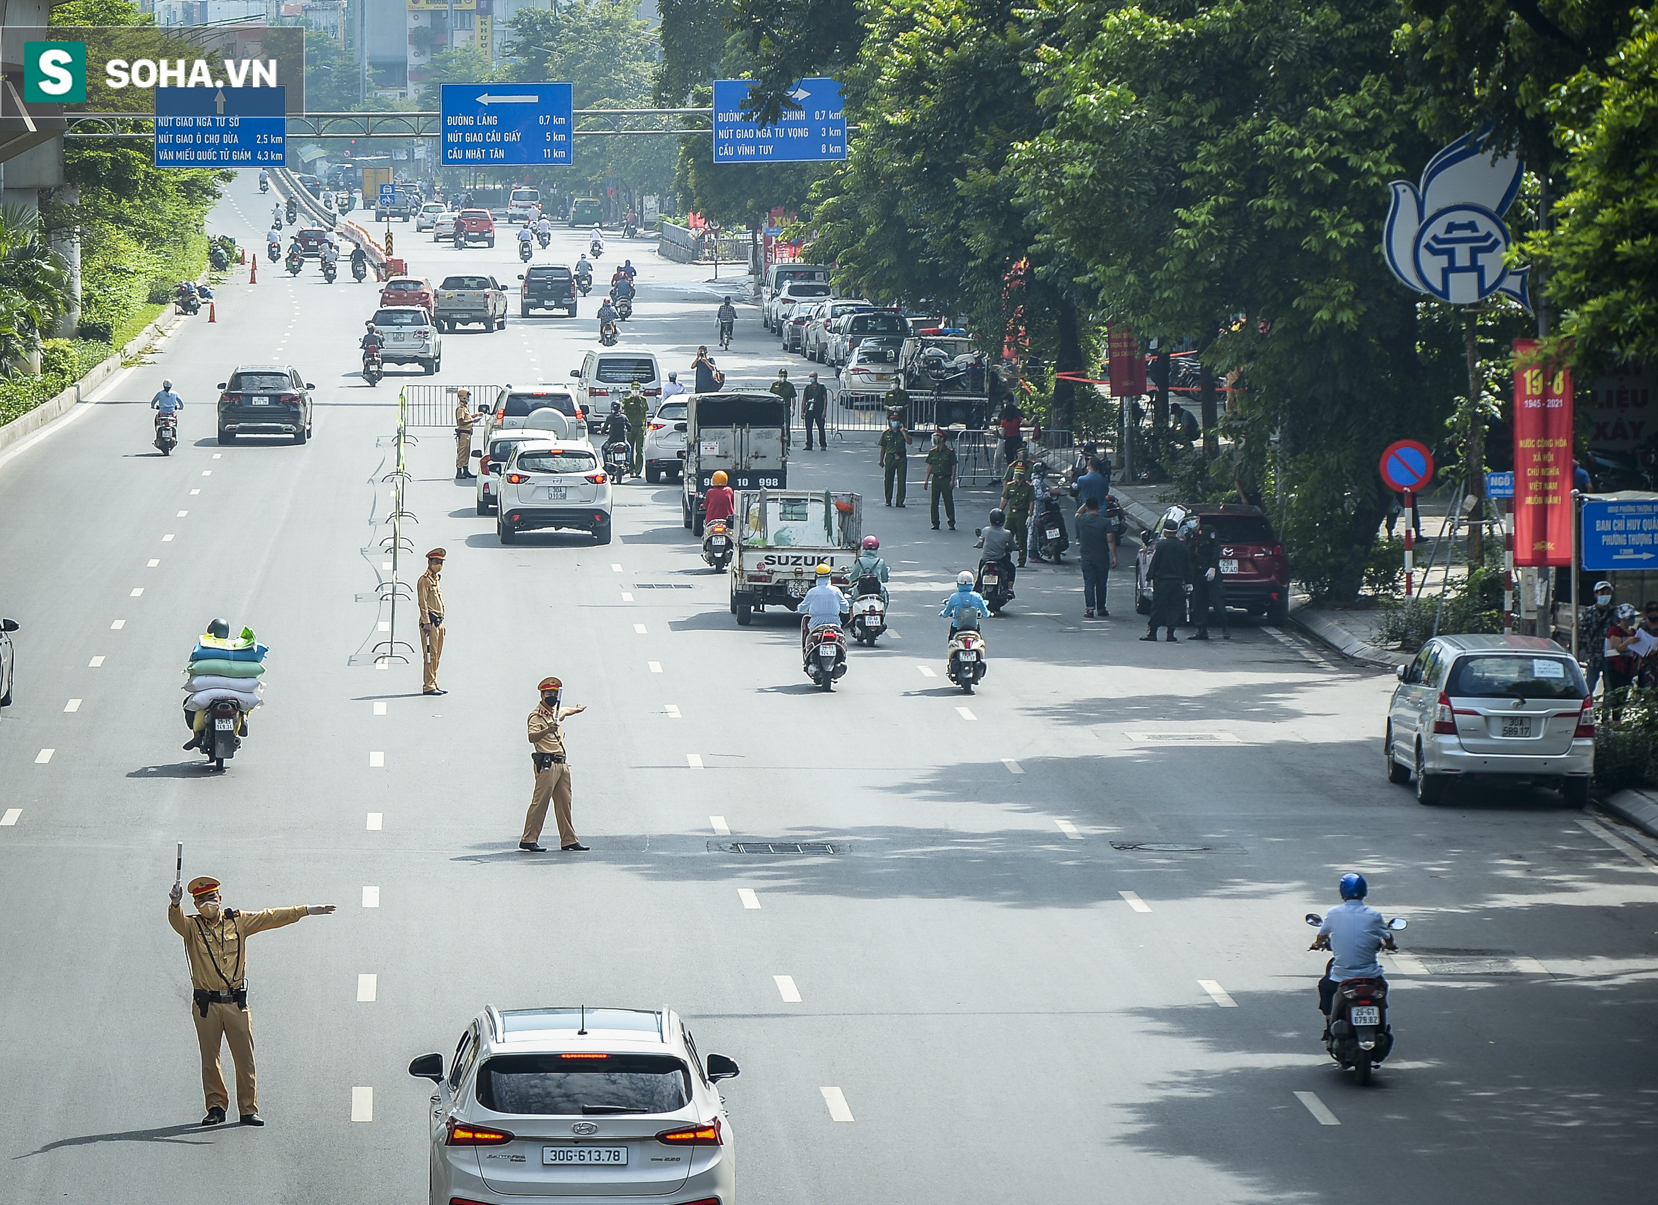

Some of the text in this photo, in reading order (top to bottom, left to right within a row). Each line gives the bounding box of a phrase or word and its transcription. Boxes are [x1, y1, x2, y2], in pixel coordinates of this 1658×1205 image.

[158, 115, 173, 127] NÚT
[175, 118, 194, 127] GIAO
[447, 113, 474, 126] ĐƯỜNG
[477, 113, 498, 126] LÁNG
[553, 115, 566, 125] km
[829, 110, 842, 120] km
[158, 132, 173, 144] NÚT
[175, 134, 194, 144] GIAO
[196, 132, 202, 144] Ô
[204, 134, 220, 146] CHỢ
[271, 134, 283, 144] km
[447, 129, 566, 142] NÚT GIAO CẦU GIẤY 5 km
[718, 127, 842, 139] NÚT GIAO NGÃ TƯ VỌNG 3 km
[159, 149, 174, 160] VĂN
[176, 147, 195, 160] MIẾU
[197, 147, 217, 161] QUỐC
[232, 148, 252, 160] GIÁM
[271, 151, 283, 160] km
[447, 147, 566, 160] CẦU NHẬT TÂN 11 km
[718, 143, 734, 156] CẦU
[737, 143, 756, 155] VĨNH
[821, 145, 827, 154] 8
[829, 144, 842, 153] km
[1524, 398, 1542, 408] 1945
[1546, 398, 1563, 408] 2021
[1592, 417, 1647, 440] XÂY
[736, 478, 749, 487] 10
[758, 478, 779, 487] 998
[1544, 481, 1558, 490] NAM
[1596, 520, 1612, 532] BAN
[1626, 519, 1641, 531] HUY
[764, 555, 835, 567] SUZUKI
[1508, 718, 1524, 727] 30A
[1503, 726, 1530, 736] 589.17
[550, 1150, 621, 1162] 30G-613.78
